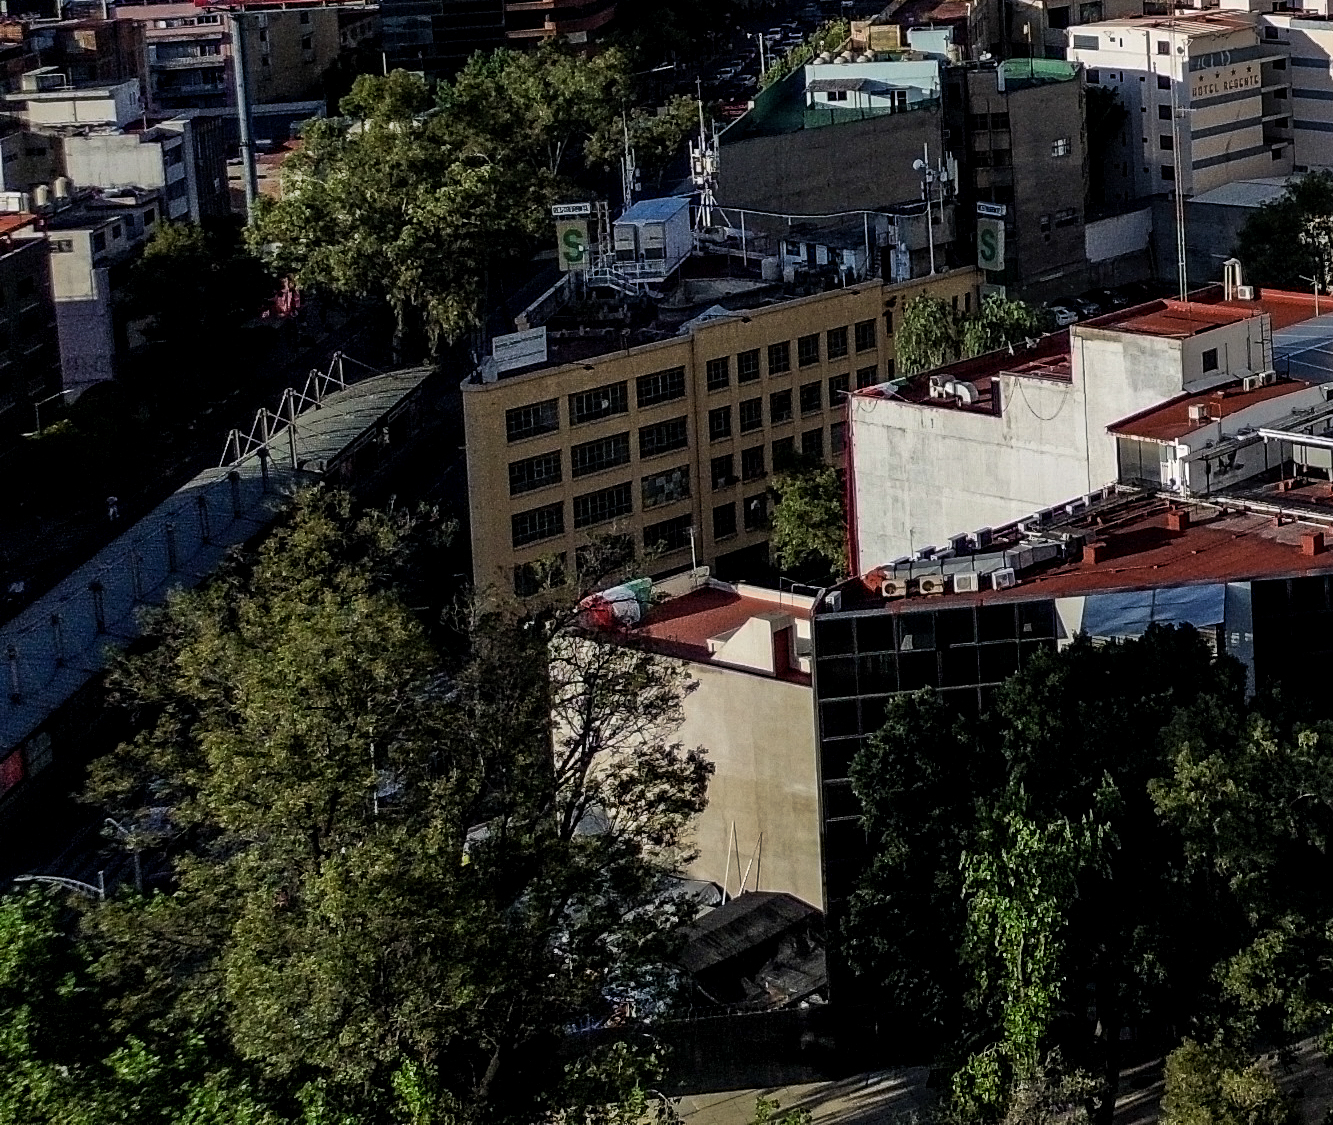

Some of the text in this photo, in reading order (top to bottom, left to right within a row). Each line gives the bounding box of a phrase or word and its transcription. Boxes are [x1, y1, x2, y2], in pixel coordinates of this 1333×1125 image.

[1192, 83, 1219, 97] HOTEL
[563, 228, 584, 262] S
[980, 228, 996, 261] S
